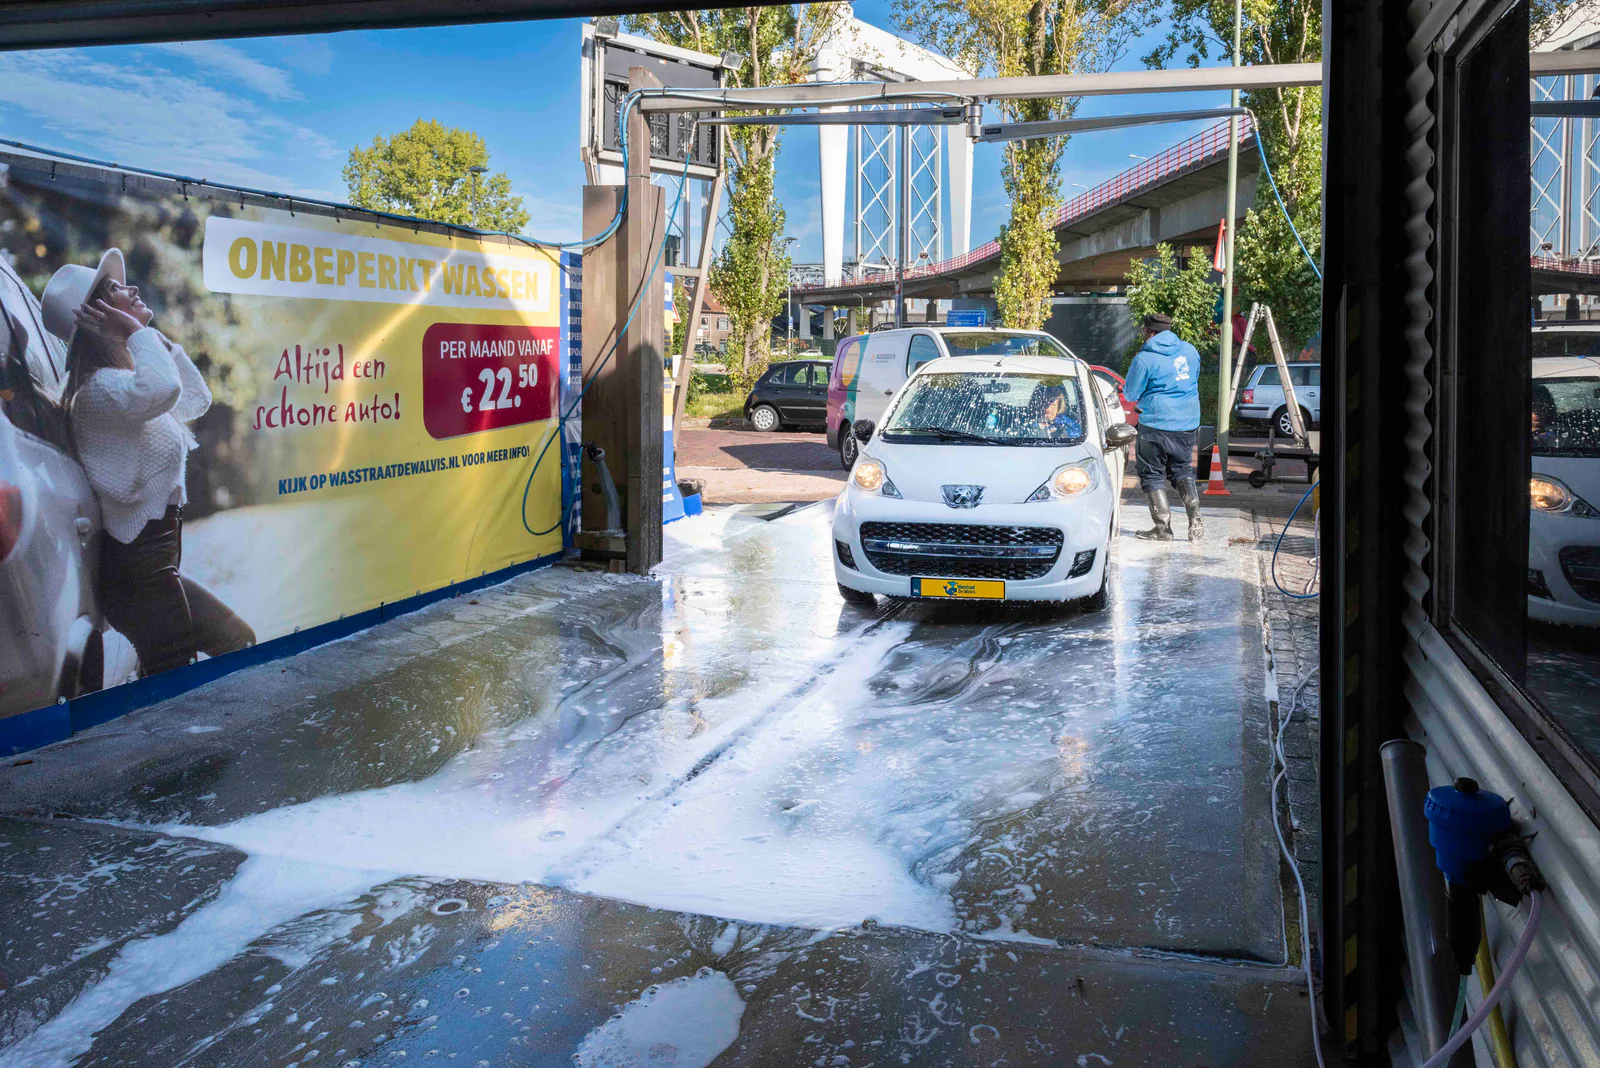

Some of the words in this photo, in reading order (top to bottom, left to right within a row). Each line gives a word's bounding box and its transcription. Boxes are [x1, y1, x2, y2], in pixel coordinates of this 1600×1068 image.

[227, 236, 436, 292] ONBEPERKT
[441, 260, 539, 300] WASSEN
[273, 344, 345, 394] Altijd
[353, 359, 386, 379] een
[439, 340, 468, 359] PER
[470, 339, 516, 358] MAAND
[517, 338, 554, 356] VANAF
[252, 385, 337, 430] schone
[344, 392, 401, 424] auto!
[460, 386, 474, 413] €
[279, 476, 307, 495] KIJK
[309, 473, 328, 490] OP
[330, 456, 460, 487] WASSTRAATDEWALVIS.NL
[461, 451, 485, 468] VOOR
[486, 448, 509, 464] MEER
[509, 445, 530, 461] INFO!
